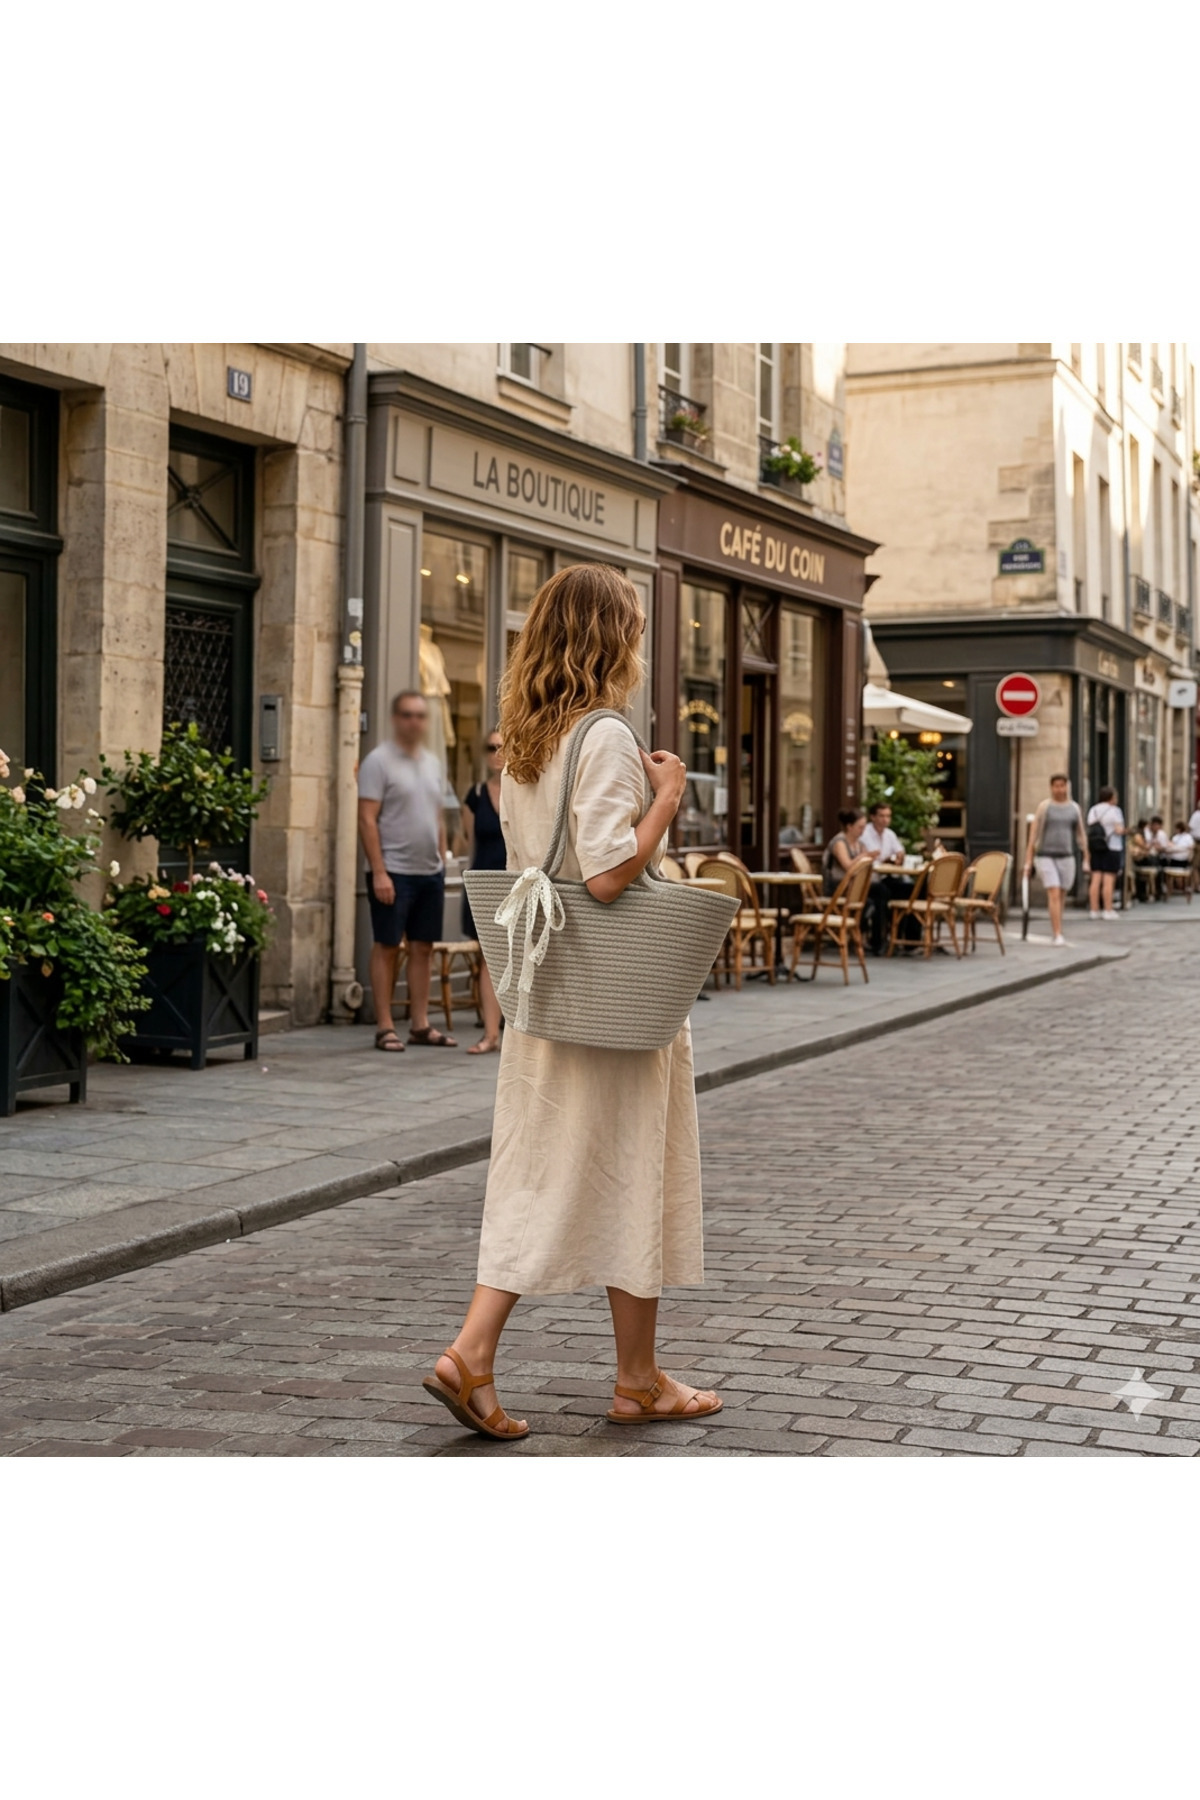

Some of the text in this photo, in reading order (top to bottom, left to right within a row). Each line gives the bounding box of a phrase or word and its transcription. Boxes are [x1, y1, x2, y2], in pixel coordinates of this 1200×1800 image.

[233, 371, 249, 396] 19
[473, 450, 605, 526] LA BOUTIQUE
[720, 521, 825, 584] CAFÉ DU COIN
